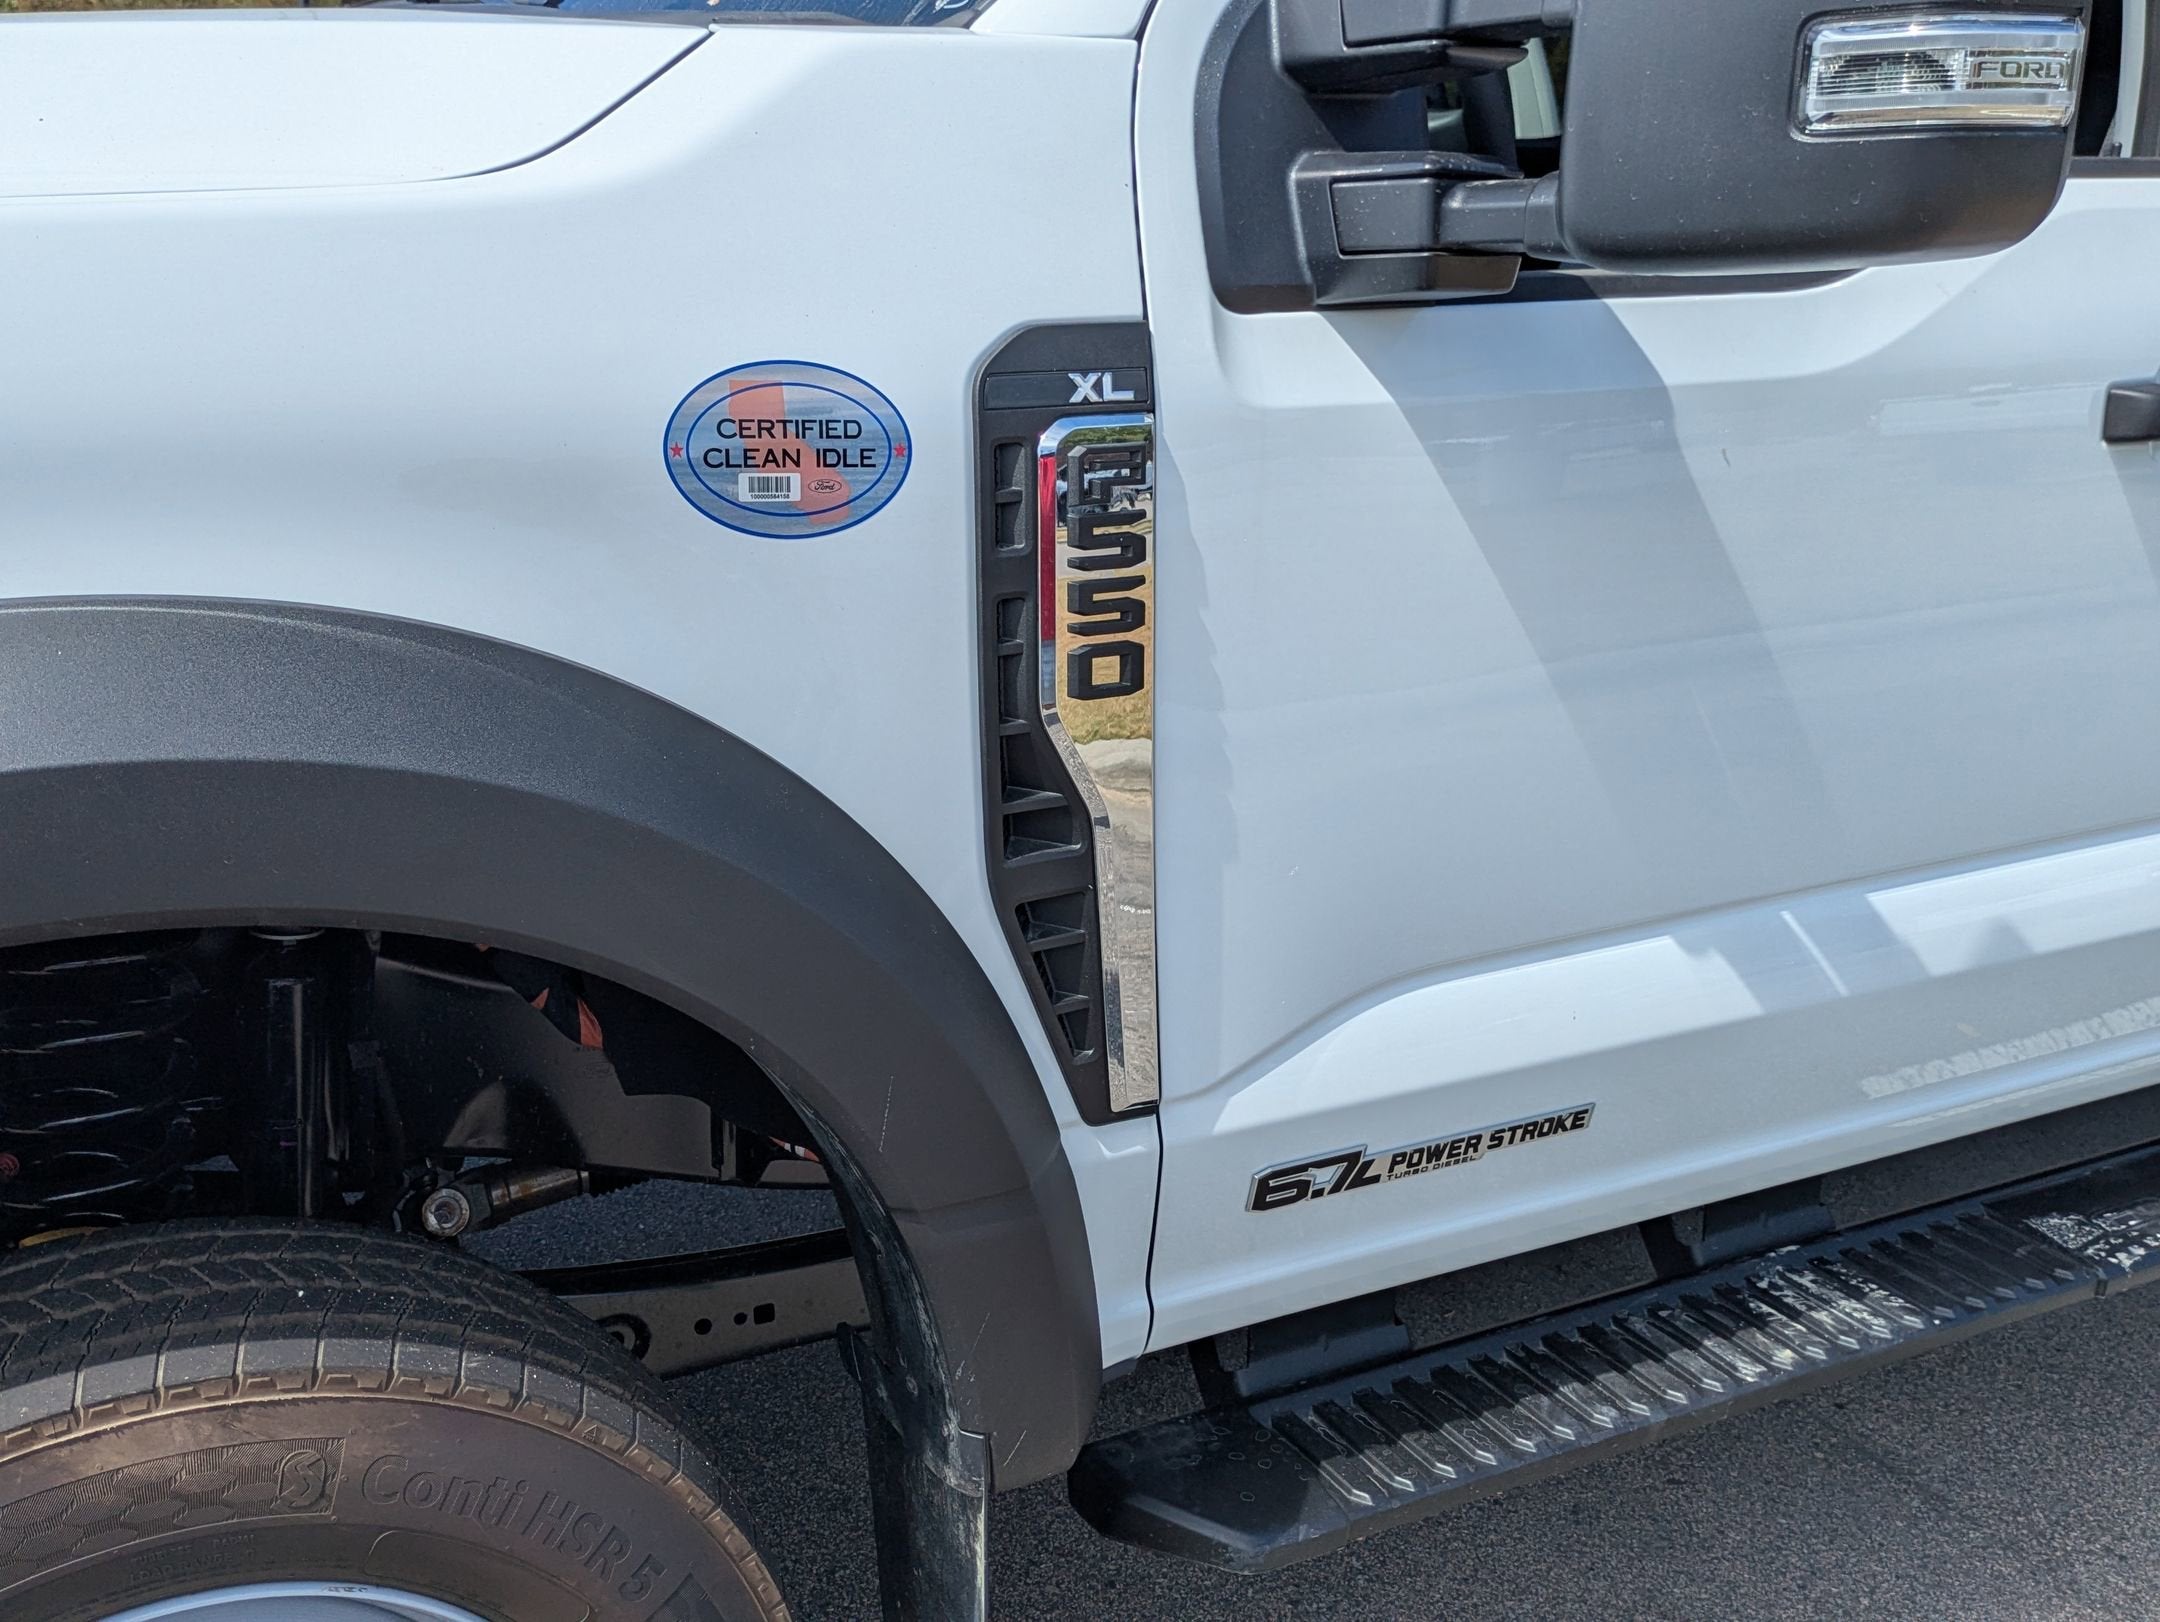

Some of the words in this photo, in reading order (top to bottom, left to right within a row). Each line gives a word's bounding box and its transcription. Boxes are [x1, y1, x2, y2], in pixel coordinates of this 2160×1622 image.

[1973, 61, 2065, 79] FORD
[1068, 372, 1135, 403] XL
[716, 418, 863, 440] CERTIFIED
[703, 447, 801, 469] CLEAN
[815, 448, 877, 468] IDLE
[813, 480, 836, 492] Ford
[1067, 443, 1147, 701] F550
[1251, 1150, 1383, 1211] 6.7L
[1387, 1134, 1483, 1174] POWER
[1486, 1108, 1590, 1151] STROKE
[1386, 1165, 1429, 1181] TURBO
[1432, 1154, 1478, 1171] DIESEL
[361, 1453, 530, 1530] Conti
[520, 1490, 634, 1584] HSR
[617, 1553, 669, 1603] 5
